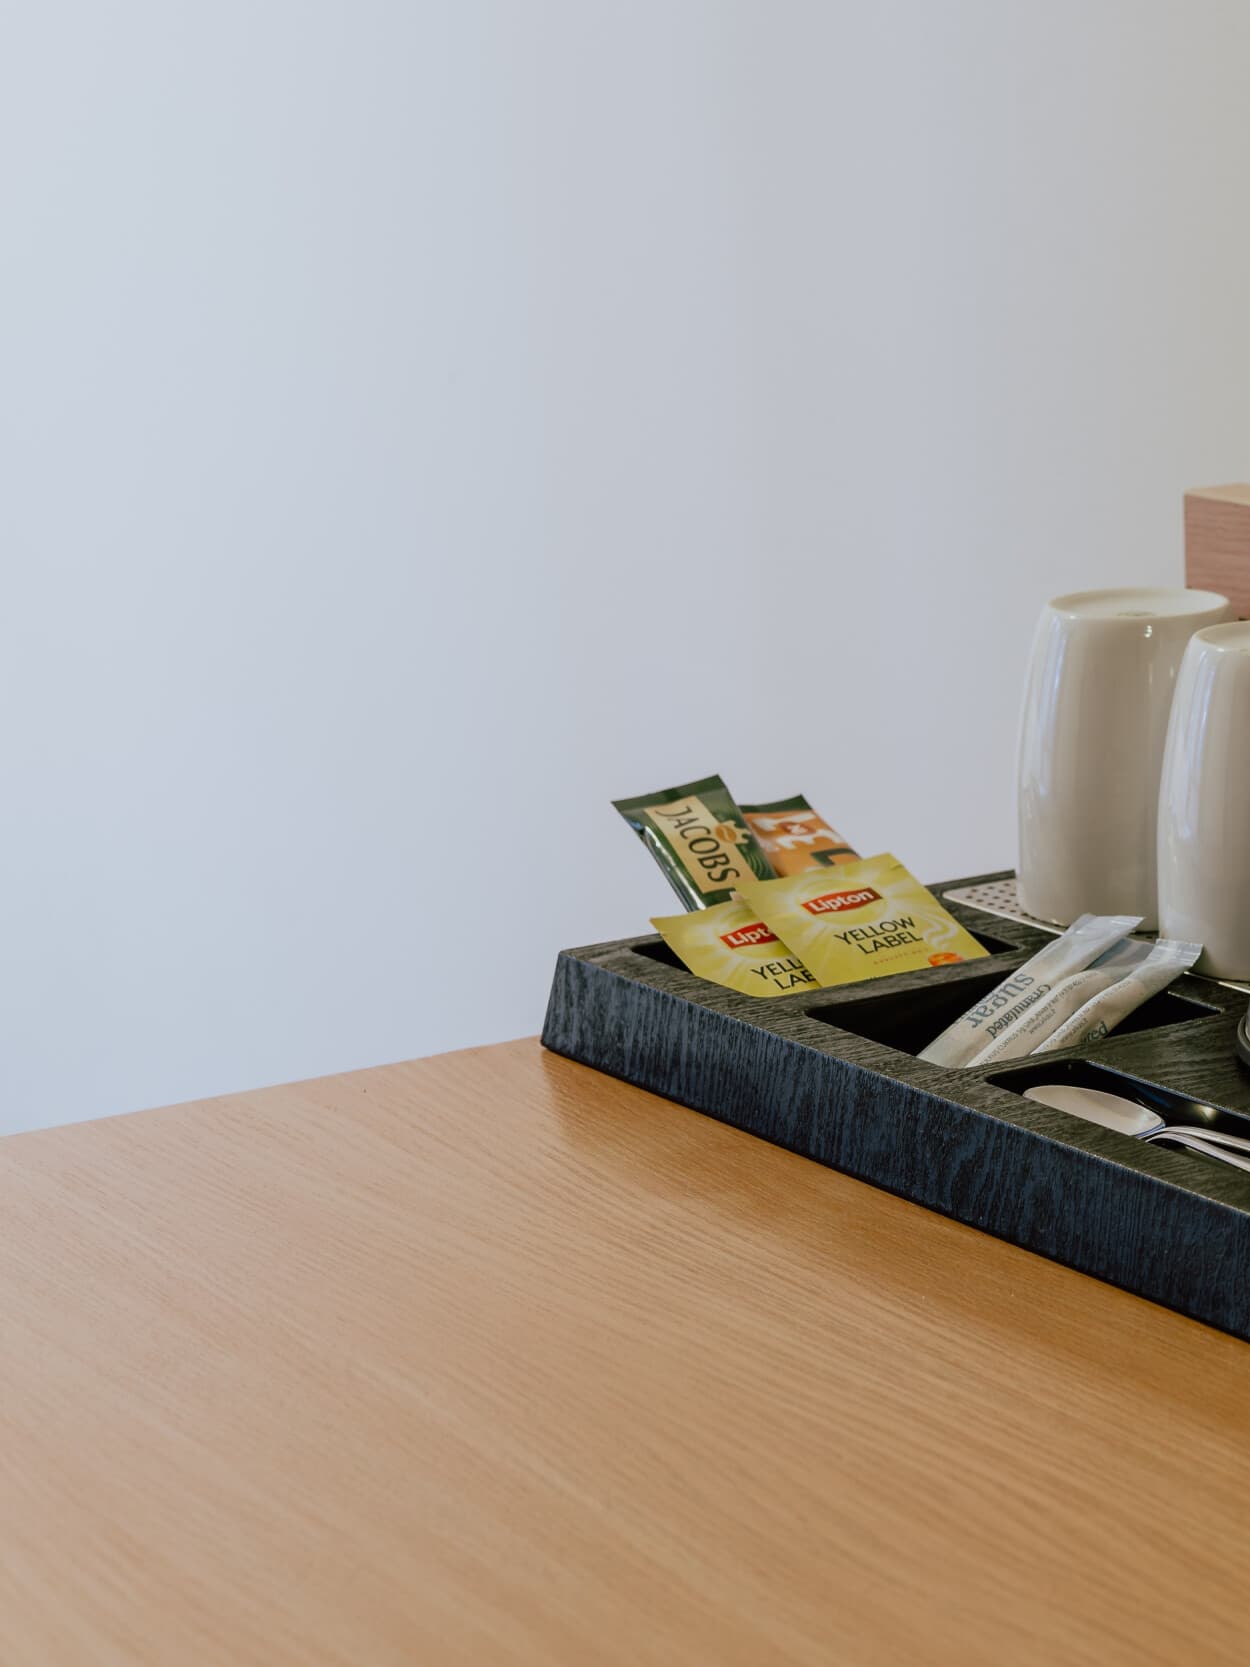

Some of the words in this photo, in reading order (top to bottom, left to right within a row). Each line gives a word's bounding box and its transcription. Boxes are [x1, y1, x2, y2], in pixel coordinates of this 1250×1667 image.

[655, 806, 740, 882] JACOBS
[807, 890, 875, 911] Lipton
[727, 928, 770, 945] Lipt
[833, 917, 916, 945] YELLOW
[858, 931, 924, 954] LABEL
[750, 958, 803, 980] YELL
[966, 973, 1035, 1028] sugar
[985, 984, 1051, 1039] Granulated
